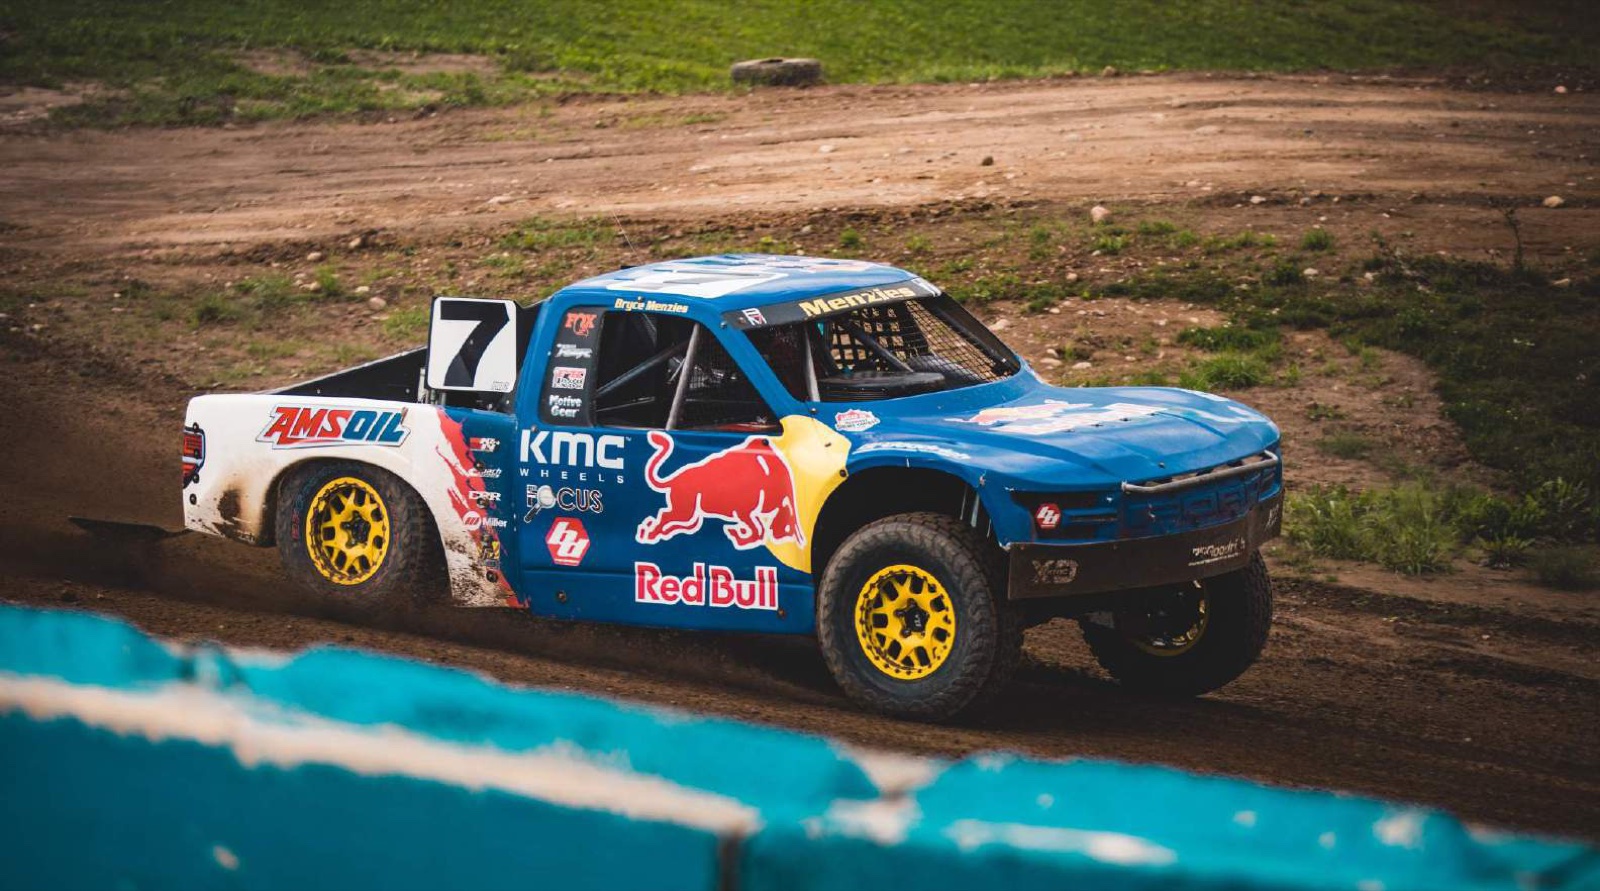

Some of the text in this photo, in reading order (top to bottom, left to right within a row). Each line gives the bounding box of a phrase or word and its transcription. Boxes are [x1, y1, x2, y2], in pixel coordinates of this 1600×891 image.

[614, 298, 689, 314] Bryce Menzies
[799, 286, 916, 317] Menzies
[440, 300, 510, 388] 7
[264, 406, 407, 446] AMSOIL
[551, 405, 579, 418] Gear
[520, 429, 625, 470] KMC
[520, 468, 624, 484] WHEELS
[482, 517, 508, 528] Miller
[634, 561, 779, 610] Red Bull
